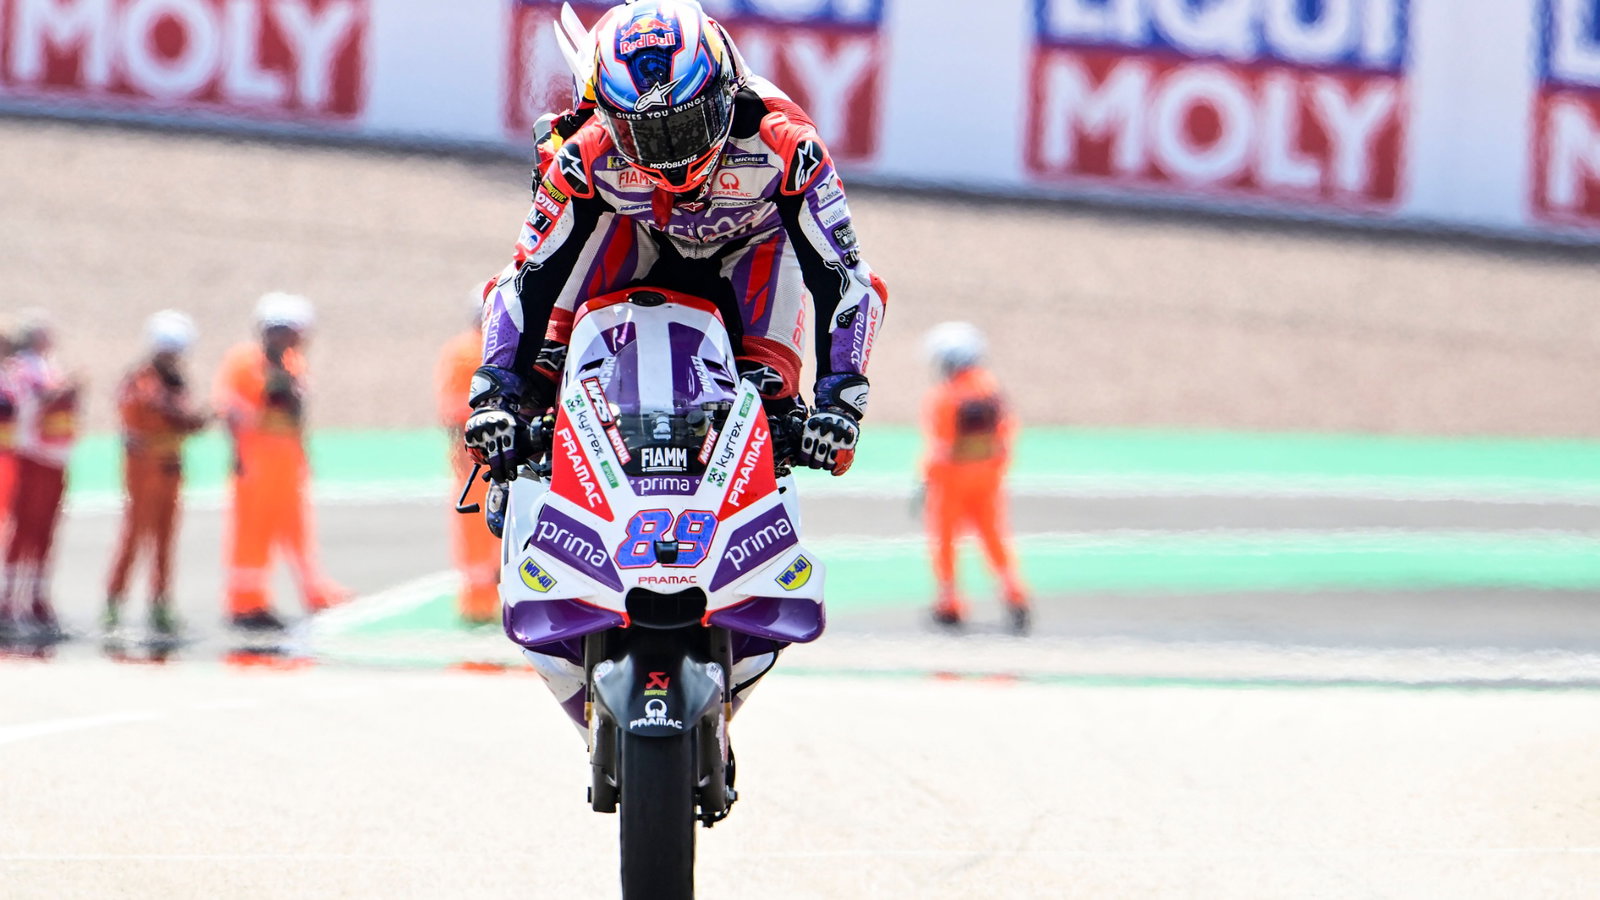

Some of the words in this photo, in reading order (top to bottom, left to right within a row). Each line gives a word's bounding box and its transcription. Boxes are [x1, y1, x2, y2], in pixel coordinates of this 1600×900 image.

[8, 0, 358, 108] MOLY
[621, 37, 646, 54] Red
[647, 33, 676, 47] Bull
[616, 112, 642, 120] GIVES
[647, 111, 669, 119] YOU
[674, 95, 706, 113] WINGS
[1043, 54, 1398, 192] MOLY
[619, 171, 654, 185] FIAM
[535, 192, 560, 217] OTUL
[487, 308, 502, 359] prima
[851, 311, 865, 365] prima
[862, 306, 878, 375] RAMAC
[600, 356, 617, 393] DUCA
[691, 355, 714, 394] DUCATI
[576, 410, 604, 457] kyrrex
[608, 427, 630, 464] MOTUL
[716, 421, 744, 468] kyrrex
[557, 427, 602, 508] PRAMAC
[641, 447, 688, 467] FIAMM
[728, 427, 768, 507] PRAMAC
[638, 477, 690, 495] prima
[537, 521, 607, 567] prima
[614, 508, 719, 570] 89
[725, 518, 791, 571] prima
[524, 560, 553, 588] WD-40
[638, 575, 697, 585] PRAMAC
[779, 558, 808, 586] WD-40
[630, 717, 682, 729] PRAMAC
